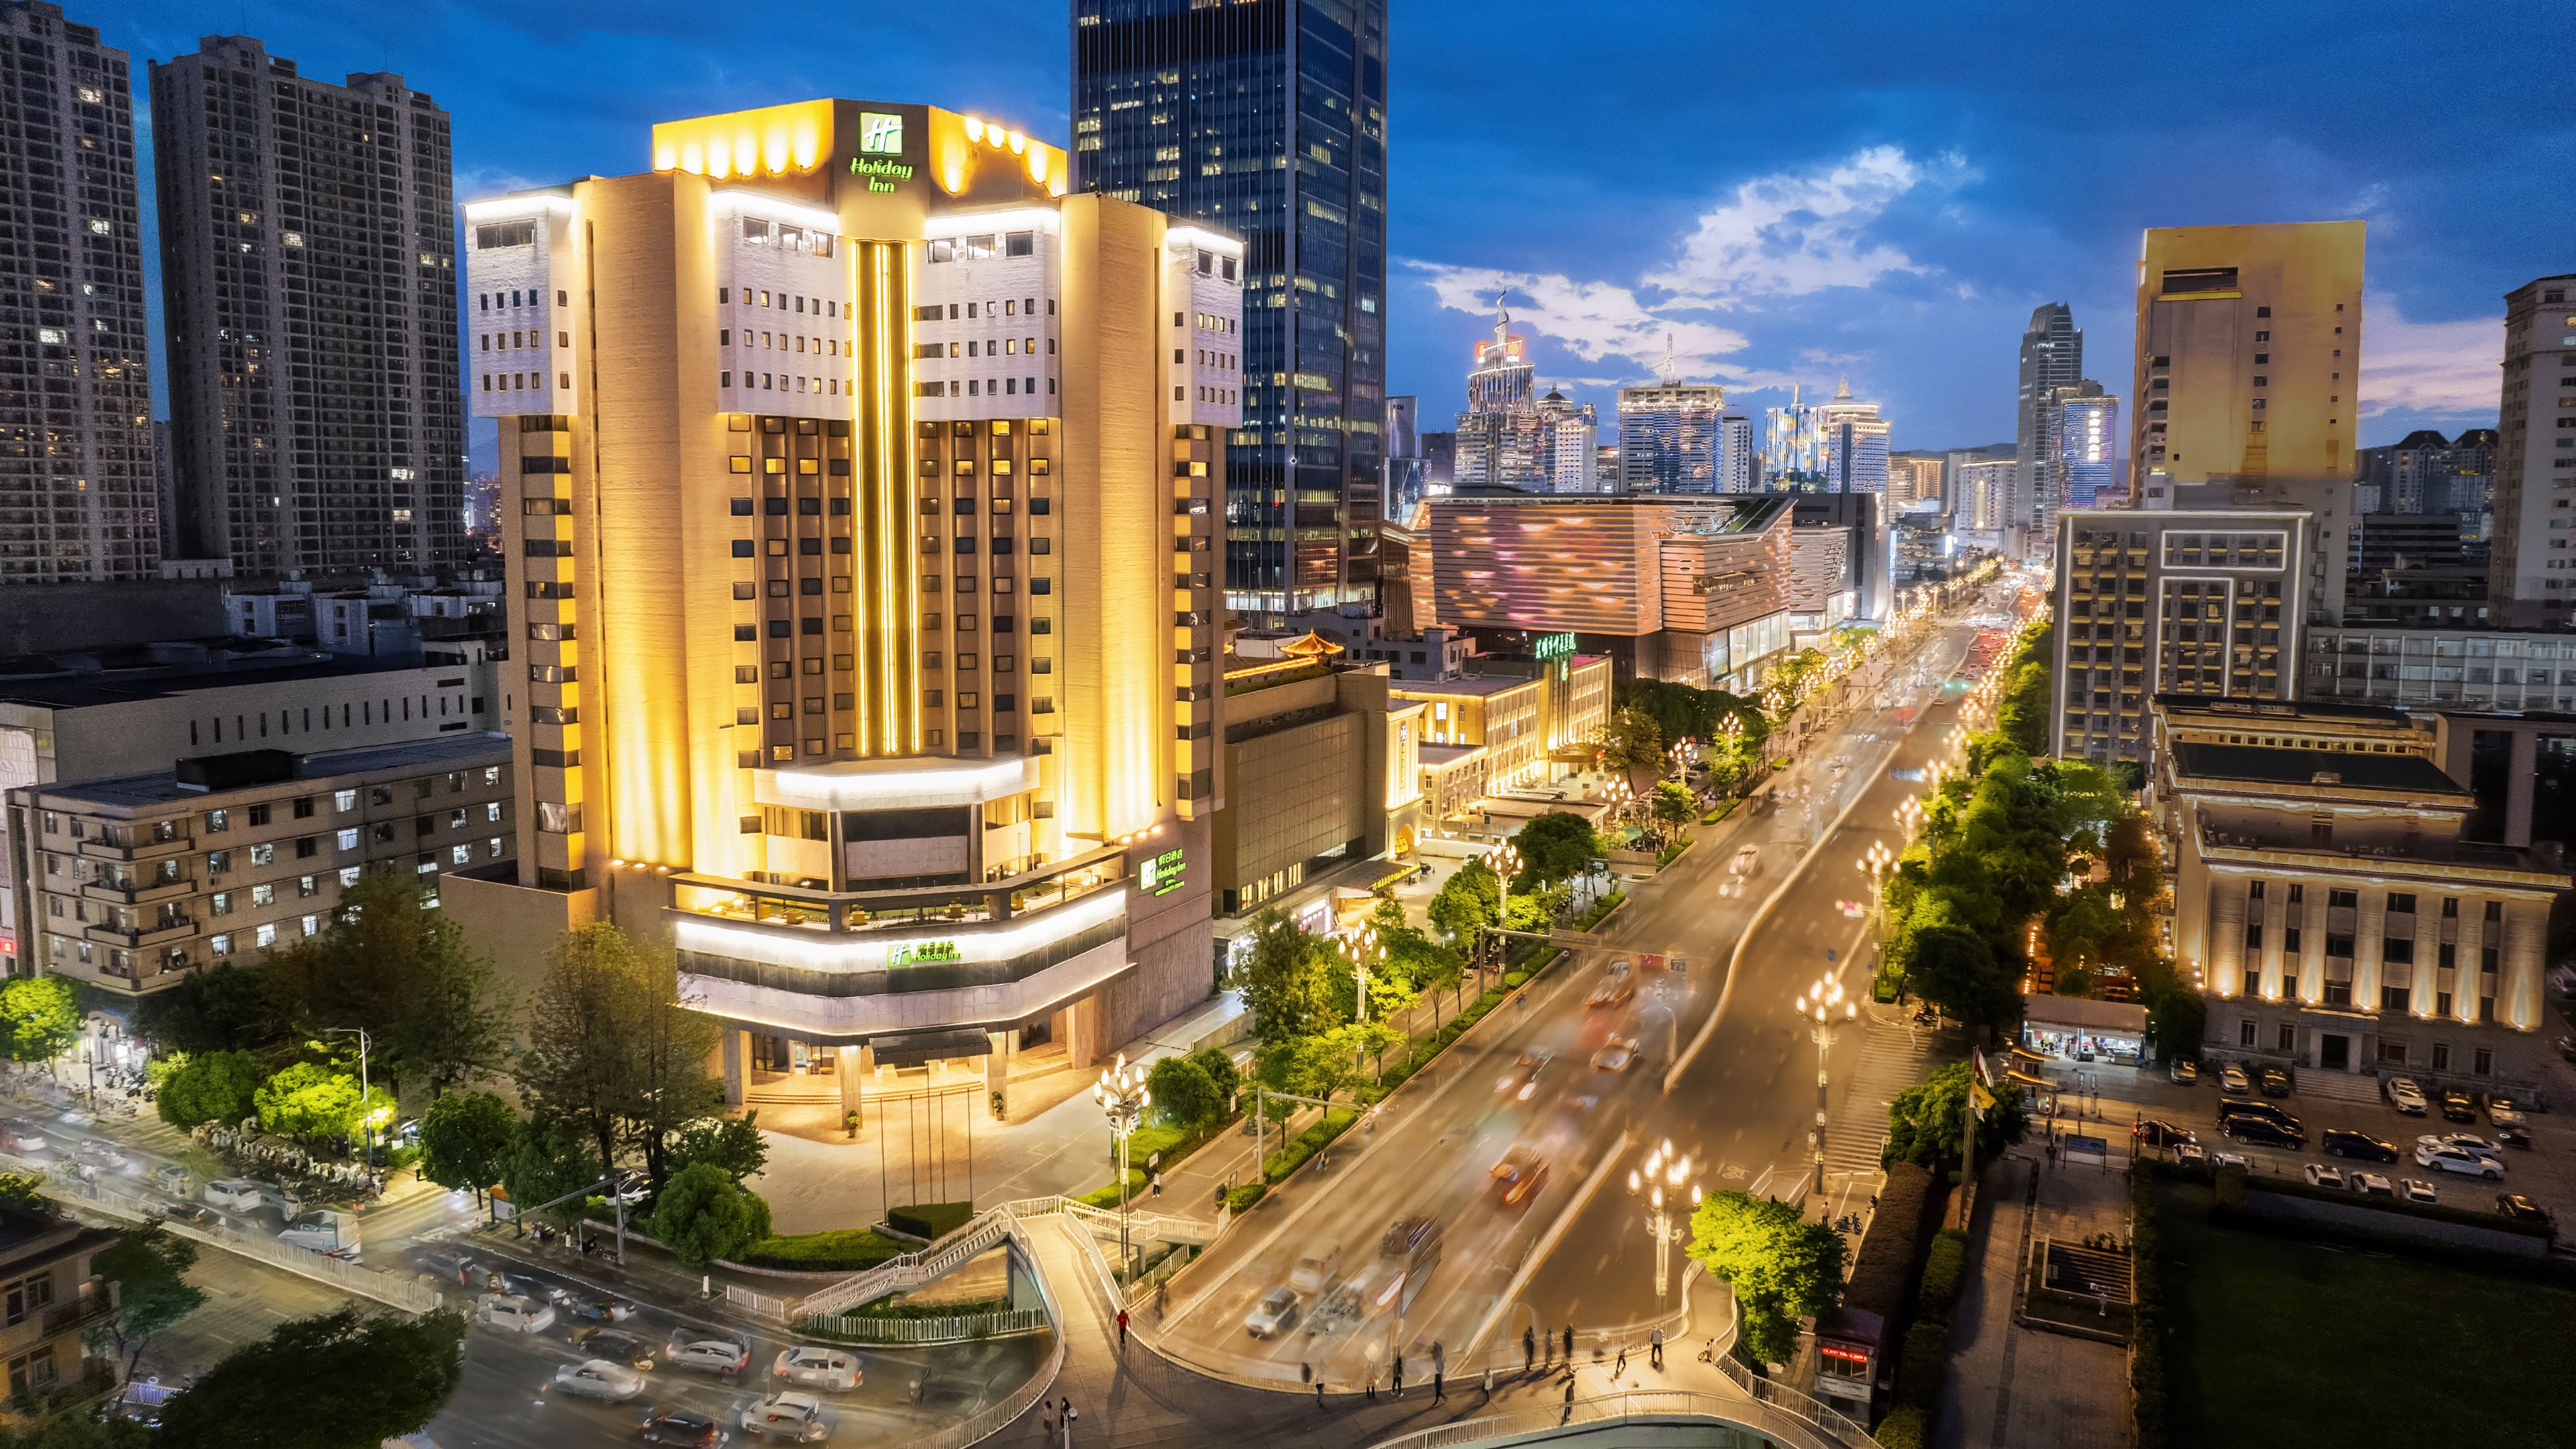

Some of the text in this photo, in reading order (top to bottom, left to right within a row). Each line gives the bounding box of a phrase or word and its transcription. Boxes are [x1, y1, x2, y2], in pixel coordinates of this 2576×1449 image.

[850, 158, 912, 182] Holiday
[869, 177, 895, 194] Inn
[1157, 861, 1187, 880] Holiday Inn
[913, 949, 963, 962] Holiday Inn
